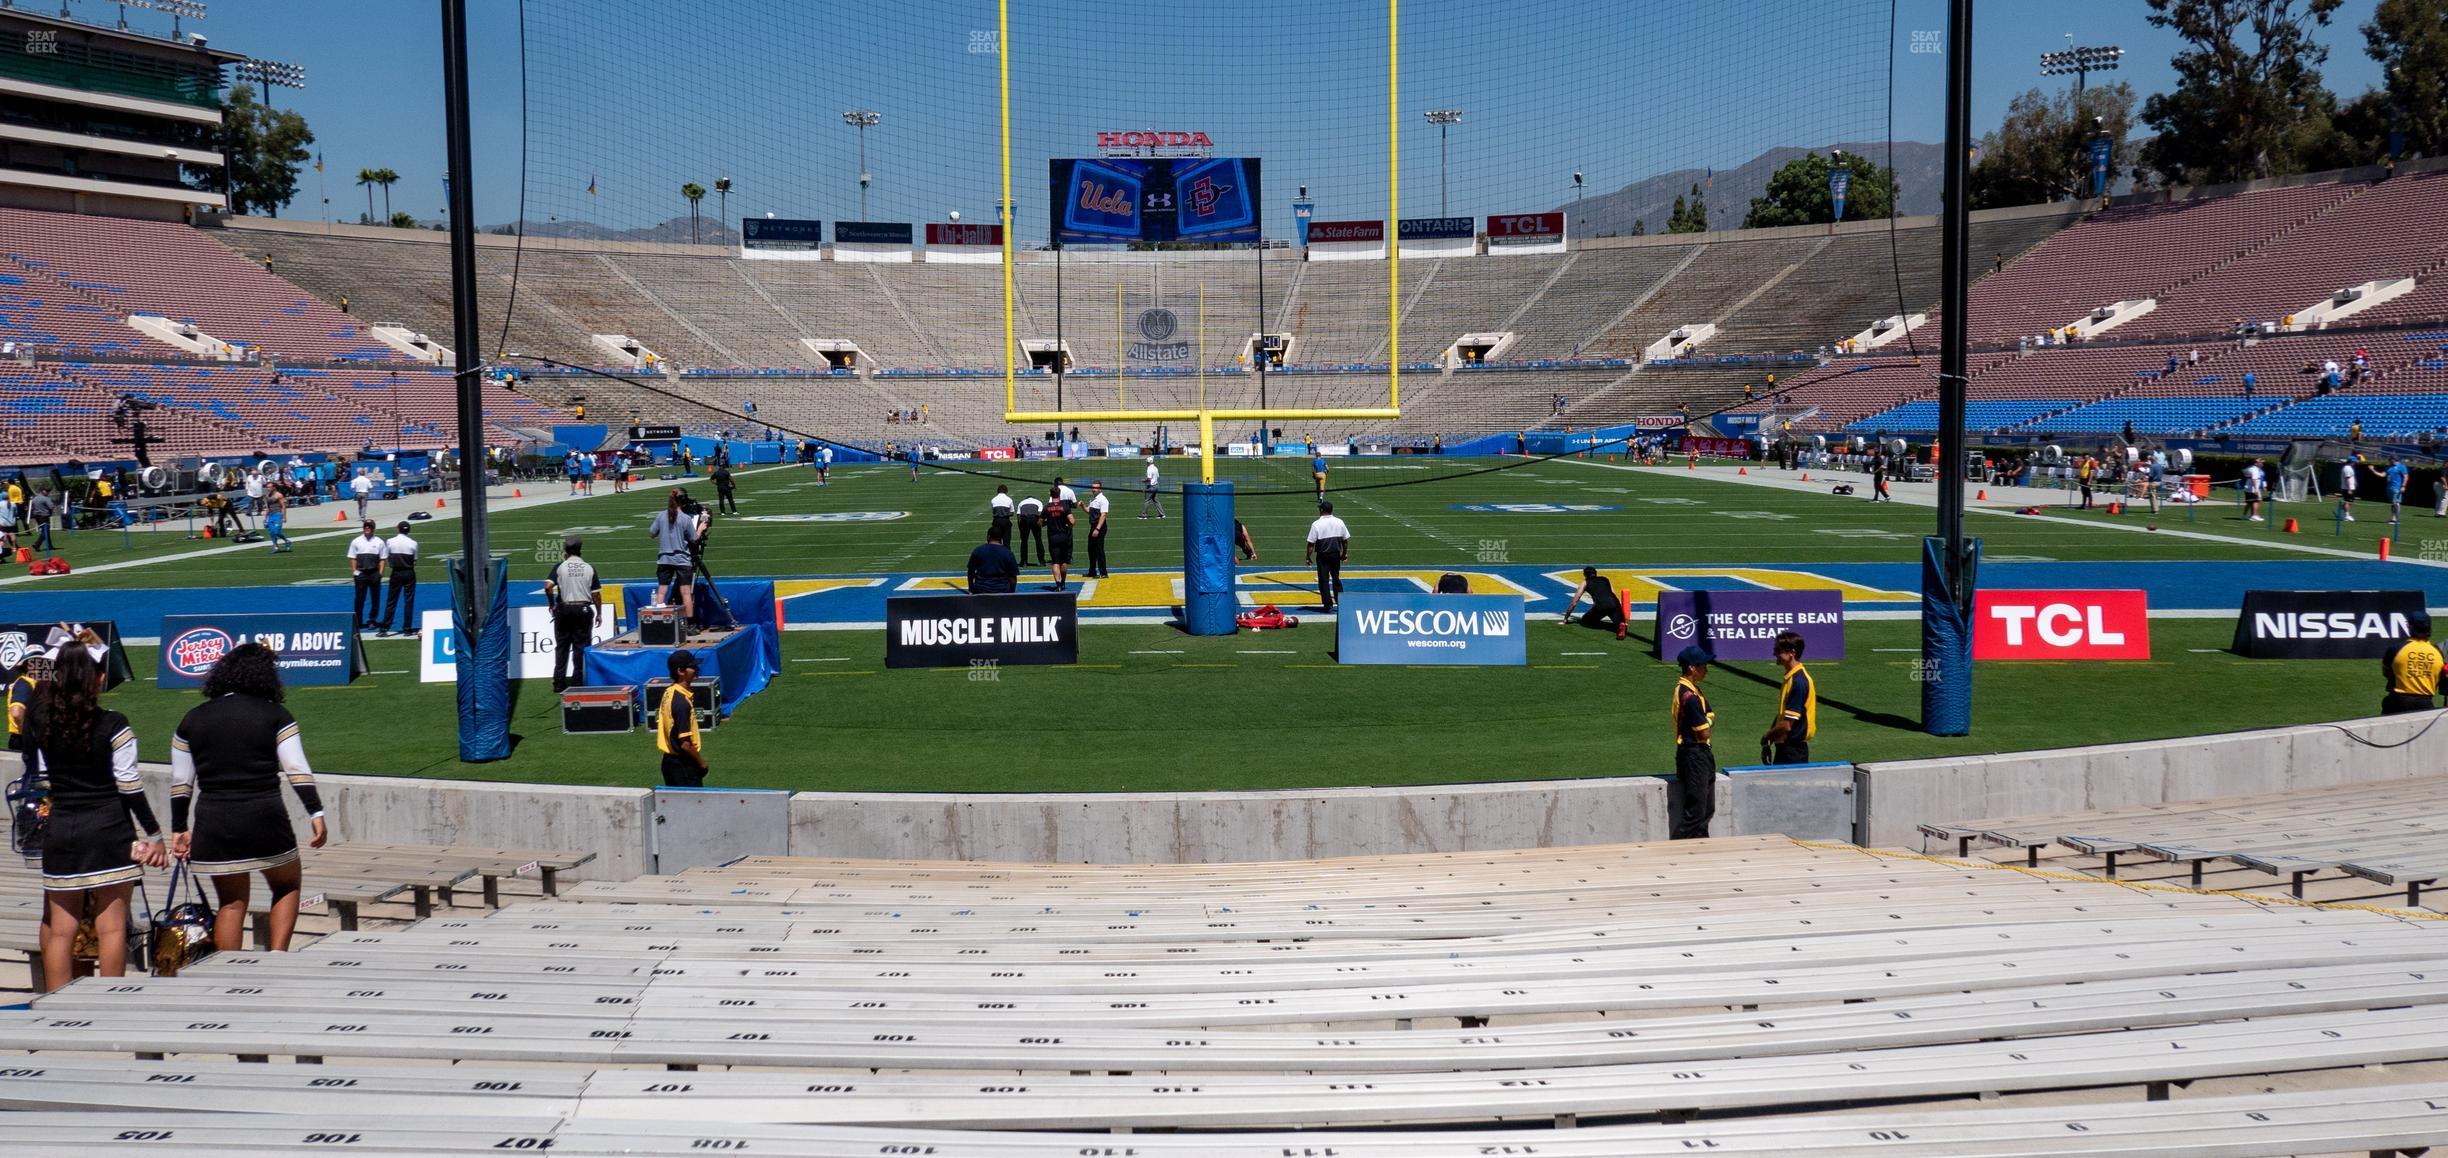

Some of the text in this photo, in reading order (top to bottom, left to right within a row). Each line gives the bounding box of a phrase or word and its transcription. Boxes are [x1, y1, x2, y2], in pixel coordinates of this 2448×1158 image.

[1097, 132, 1213, 147] HONDA
[1081, 181, 1133, 217] Ucla
[1500, 216, 1550, 233] TCL
[1264, 336, 1280, 348] 40
[1128, 343, 1188, 361] Allstate
[1636, 418, 1684, 427] HONDA
[985, 451, 1010, 459] TCL
[1356, 610, 1479, 635] WESCOM
[1706, 612, 1838, 624] THE COFFEE BEAN
[1991, 603, 2125, 647] TCL
[901, 616, 1060, 645] MUSCLE MILK
[1707, 628, 1716, 639] &
[1717, 628, 1746, 639] TEA
[177, 637, 224, 654] Jersey
[291, 632, 346, 652] ABOVE.
[1407, 639, 1467, 650] wescom.org
[4, 652, 16, 663] 12
[2407, 652, 2435, 661] CSC
[2407, 661, 2434, 671] EVENT
[470, 992, 508, 1000] 104
[594, 996, 634, 1006] 105
[48, 1020, 93, 1028] 102
[186, 1022, 230, 1030] 103
[325, 1024, 367, 1032] 104
[450, 1026, 493, 1034] 105
[590, 1030, 633, 1039] 106
[1607, 1030, 1639, 1038] 10
[726, 1033, 770, 1041] 107
[872, 1034, 917, 1042] 108
[1019, 1037, 1061, 1045] 109
[1458, 1037, 1503, 1045] 112
[0, 1068, 46, 1078] 103
[145, 1074, 196, 1083] 104
[307, 1078, 358, 1087] 105
[472, 1081, 522, 1091] 106
[642, 1084, 692, 1093] 107
[806, 1085, 854, 1093] 108
[113, 1130, 174, 1141] 105
[302, 1133, 361, 1144] 106
[1868, 1130, 1910, 1141] 10
[494, 1137, 556, 1151] 107
[691, 1139, 749, 1150] 108
[1681, 1139, 1720, 1149] 11
[879, 1145, 935, 1155] 109
[1079, 1147, 1134, 1157] 110
[1282, 1147, 1339, 1158] 111
[1480, 1146, 1538, 1155] 112
